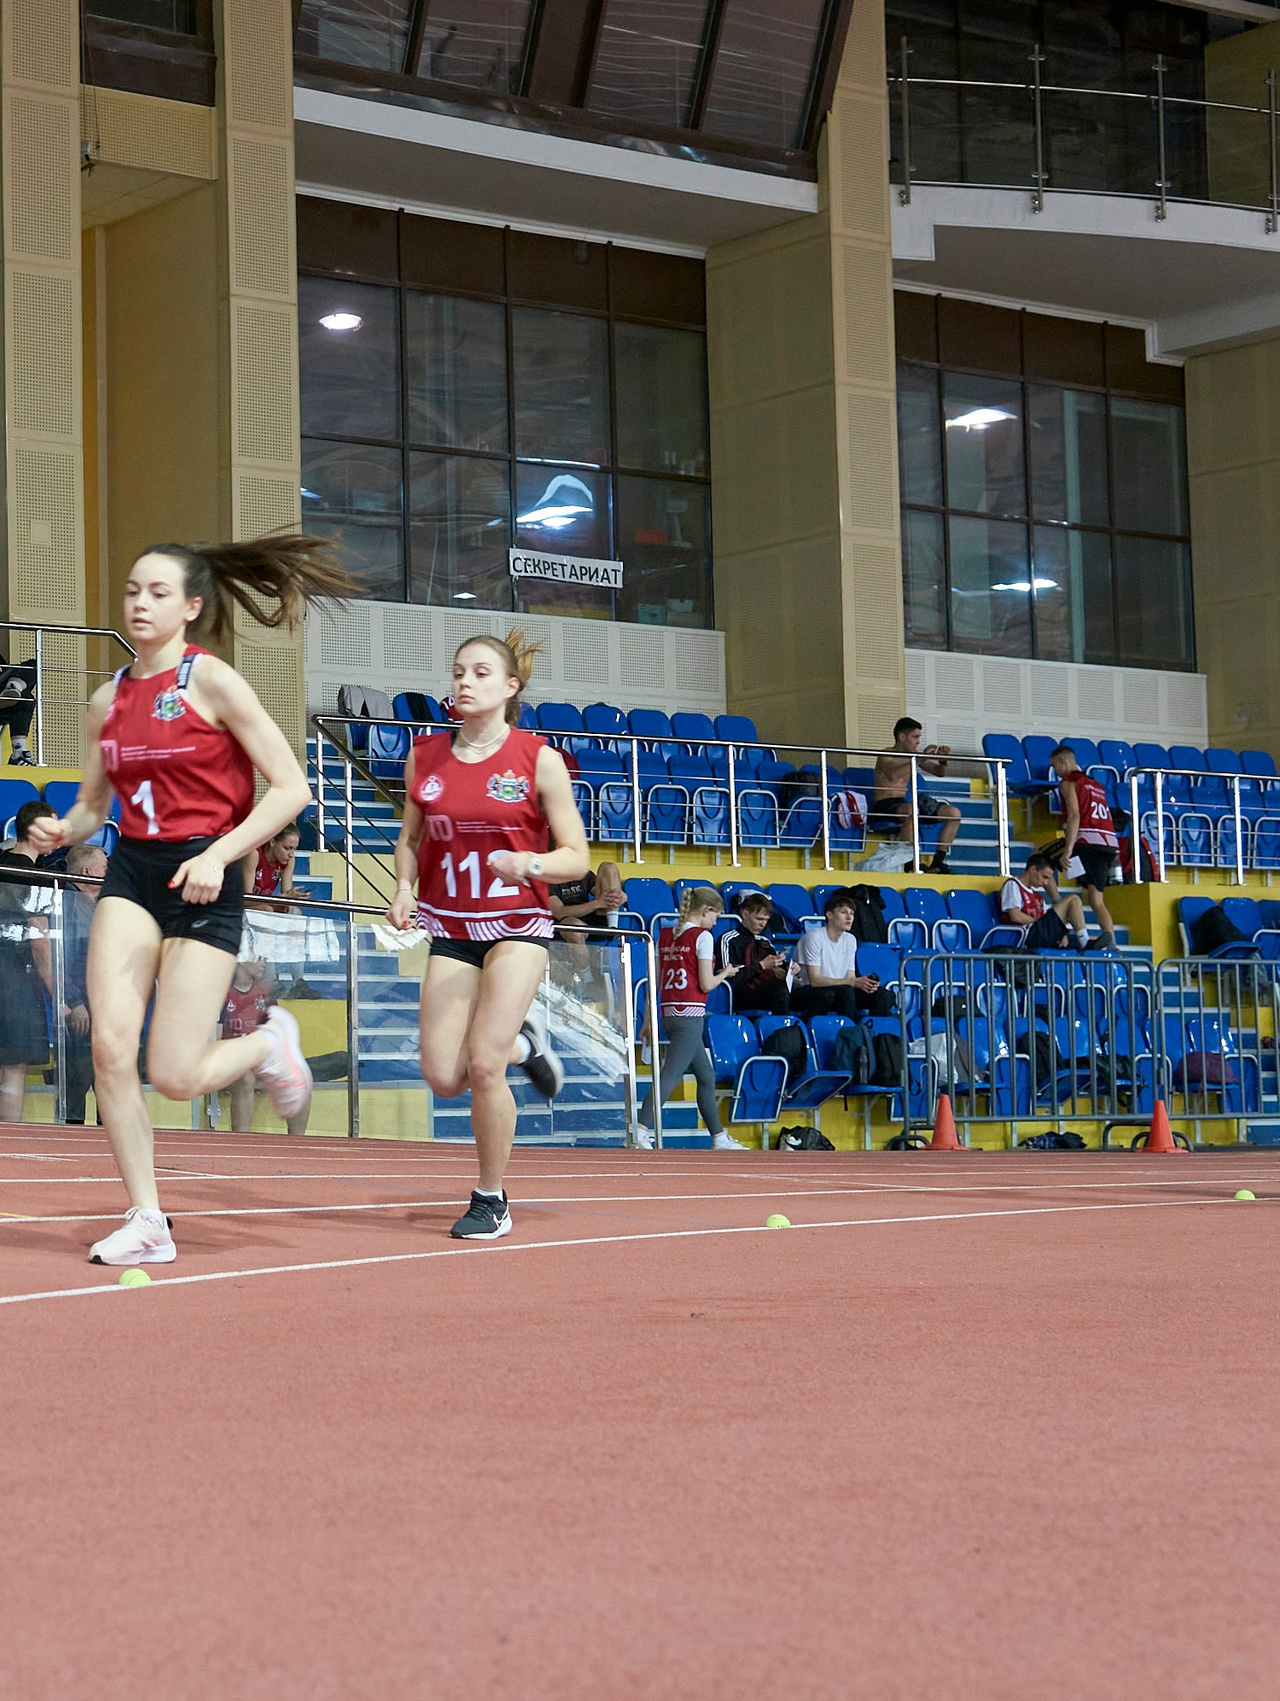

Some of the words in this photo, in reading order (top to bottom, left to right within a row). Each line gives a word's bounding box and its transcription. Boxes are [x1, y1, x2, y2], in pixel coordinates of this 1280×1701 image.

[512, 556, 620, 585] СЕКРЕТАРИАТ
[131, 780, 160, 836] 1
[1091, 801, 1110, 819] 20
[440, 849, 520, 899] 112
[665, 968, 688, 990] 23
